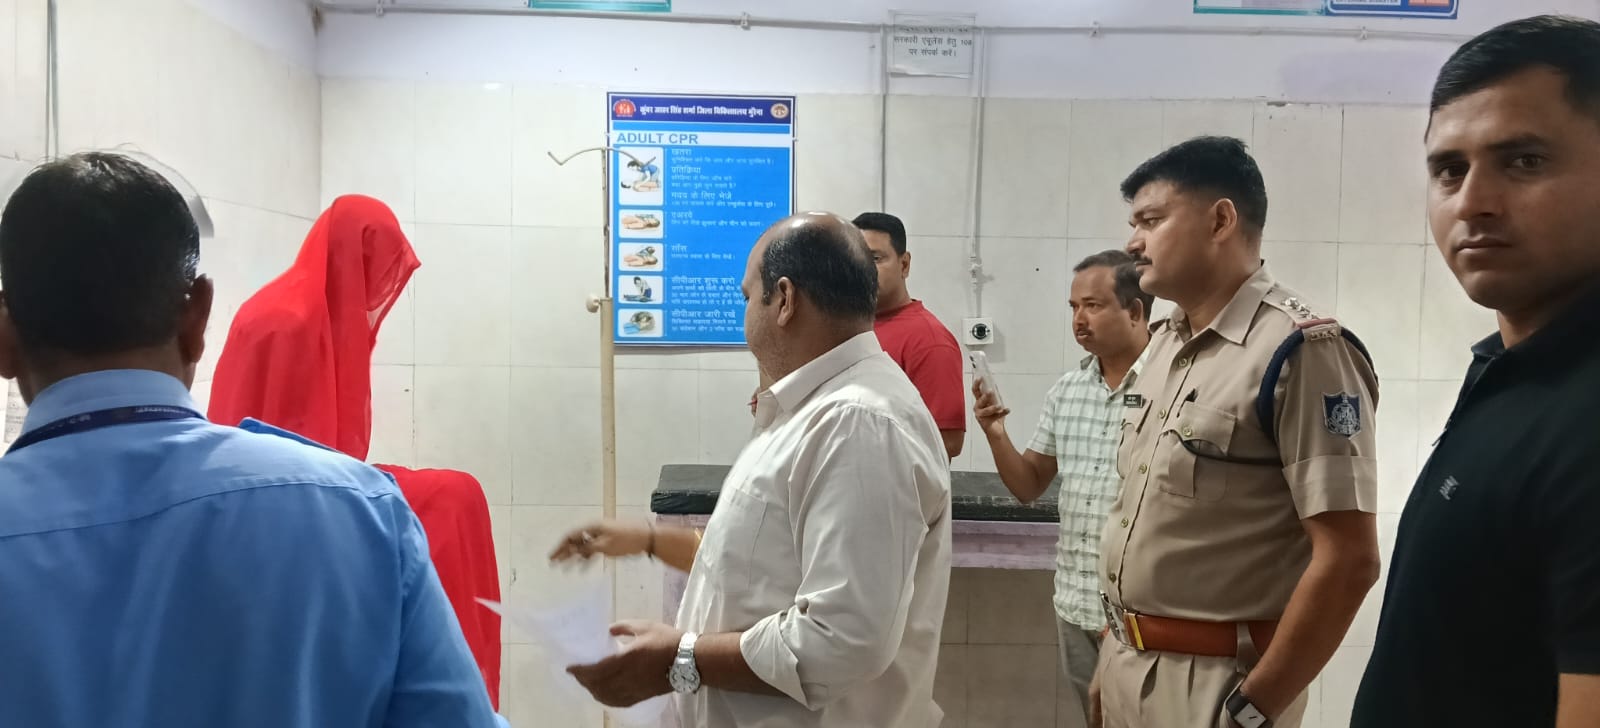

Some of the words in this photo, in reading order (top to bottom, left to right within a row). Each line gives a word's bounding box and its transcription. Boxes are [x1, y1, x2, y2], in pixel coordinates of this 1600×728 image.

[908, 48, 918, 56] पर
[616, 132, 665, 144] ADULT
[668, 133, 698, 144] CPR
